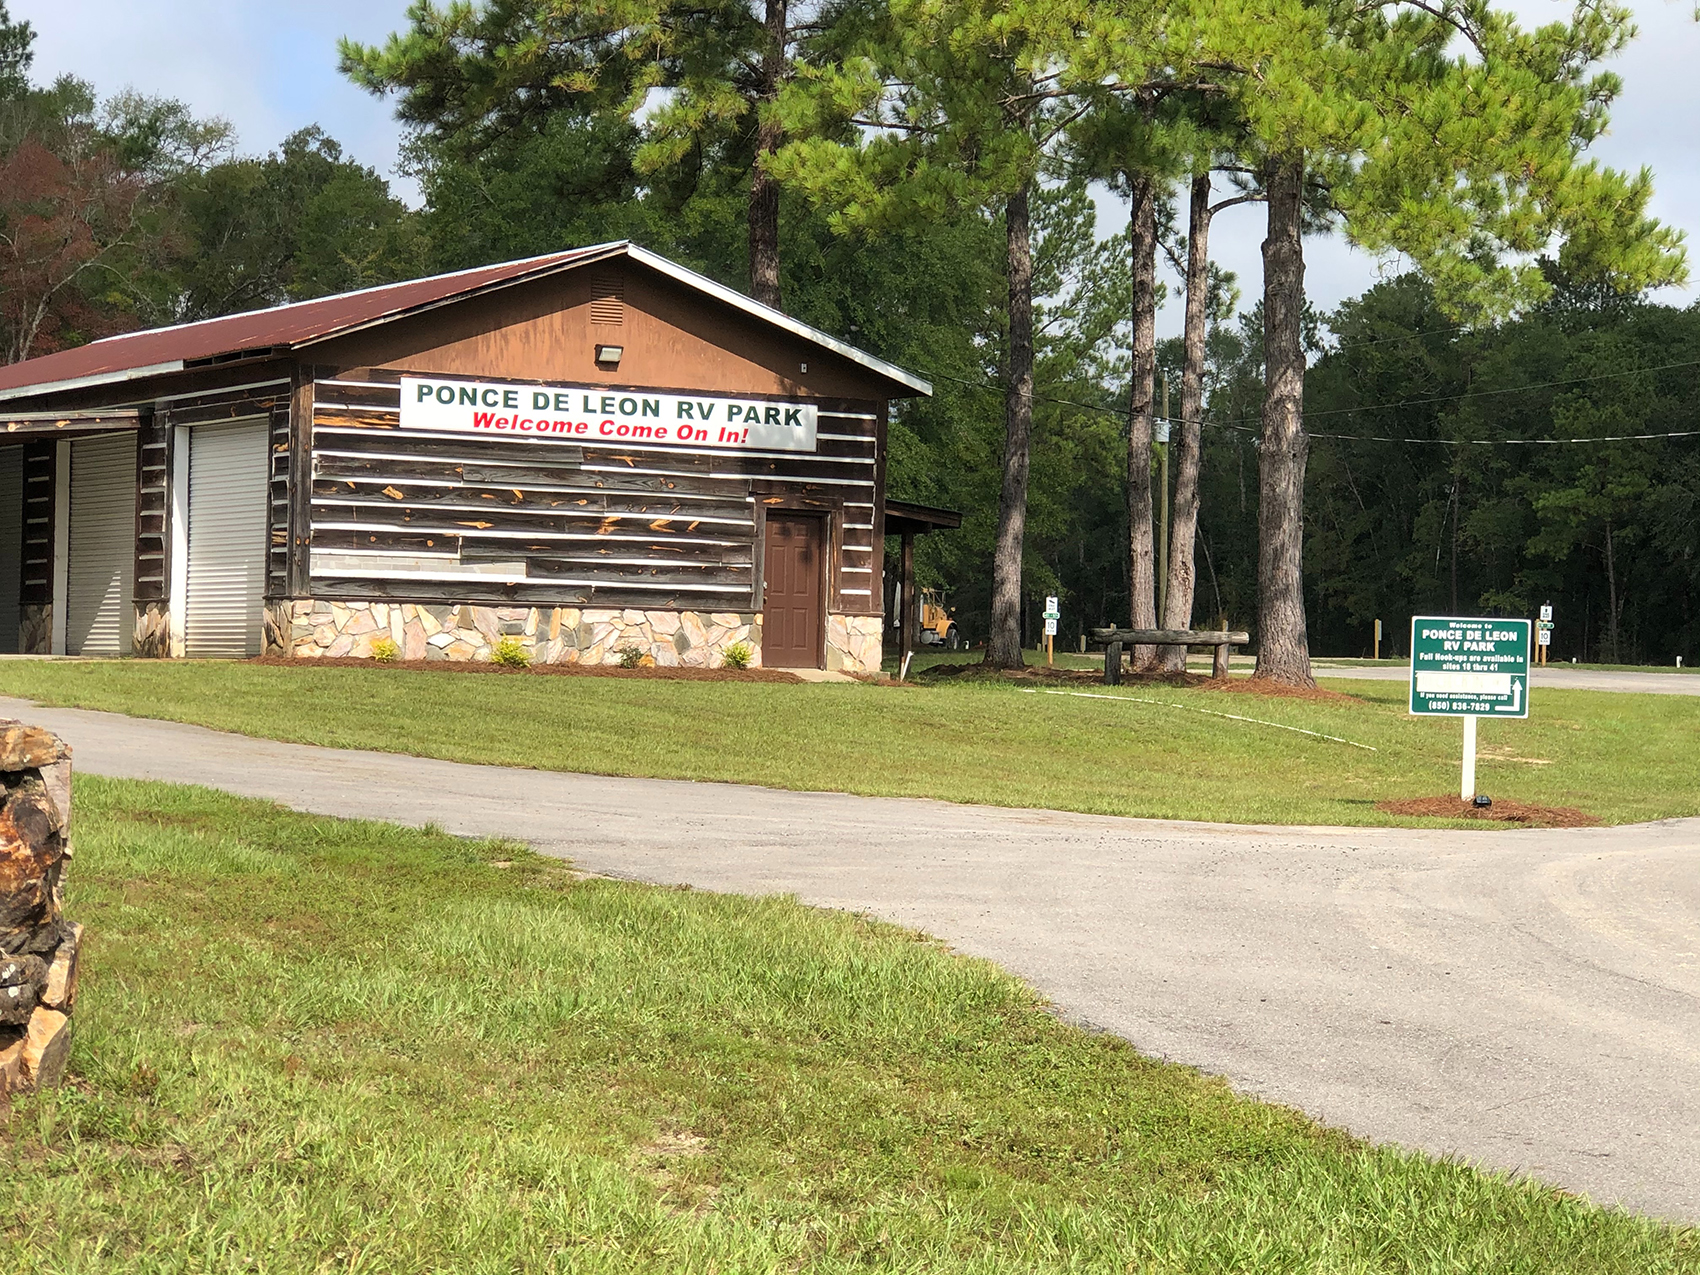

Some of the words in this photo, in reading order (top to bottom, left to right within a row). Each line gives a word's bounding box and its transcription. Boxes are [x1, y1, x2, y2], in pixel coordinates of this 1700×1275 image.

[417, 384, 519, 408] PONCE
[533, 391, 570, 412] DE
[582, 394, 660, 417] LEON
[676, 400, 714, 420] RV
[727, 403, 804, 427] PARK
[472, 411, 588, 434] Welcome
[598, 419, 667, 439] Come
[676, 425, 712, 442] On
[718, 426, 750, 444] In!
[1047, 621, 1055, 629] 10
[1422, 629, 1463, 640] PONCE
[1466, 630, 1482, 640] DE
[1485, 631, 1518, 641] LEON
[1540, 632, 1549, 640] 10
[1444, 641, 1460, 651] RV
[1463, 641, 1495, 652] PARK
[1419, 652, 1433, 660] Full
[1482, 655, 1515, 663] available
[1442, 662, 1460, 670] sites
[1428, 700, 1450, 711] (850)
